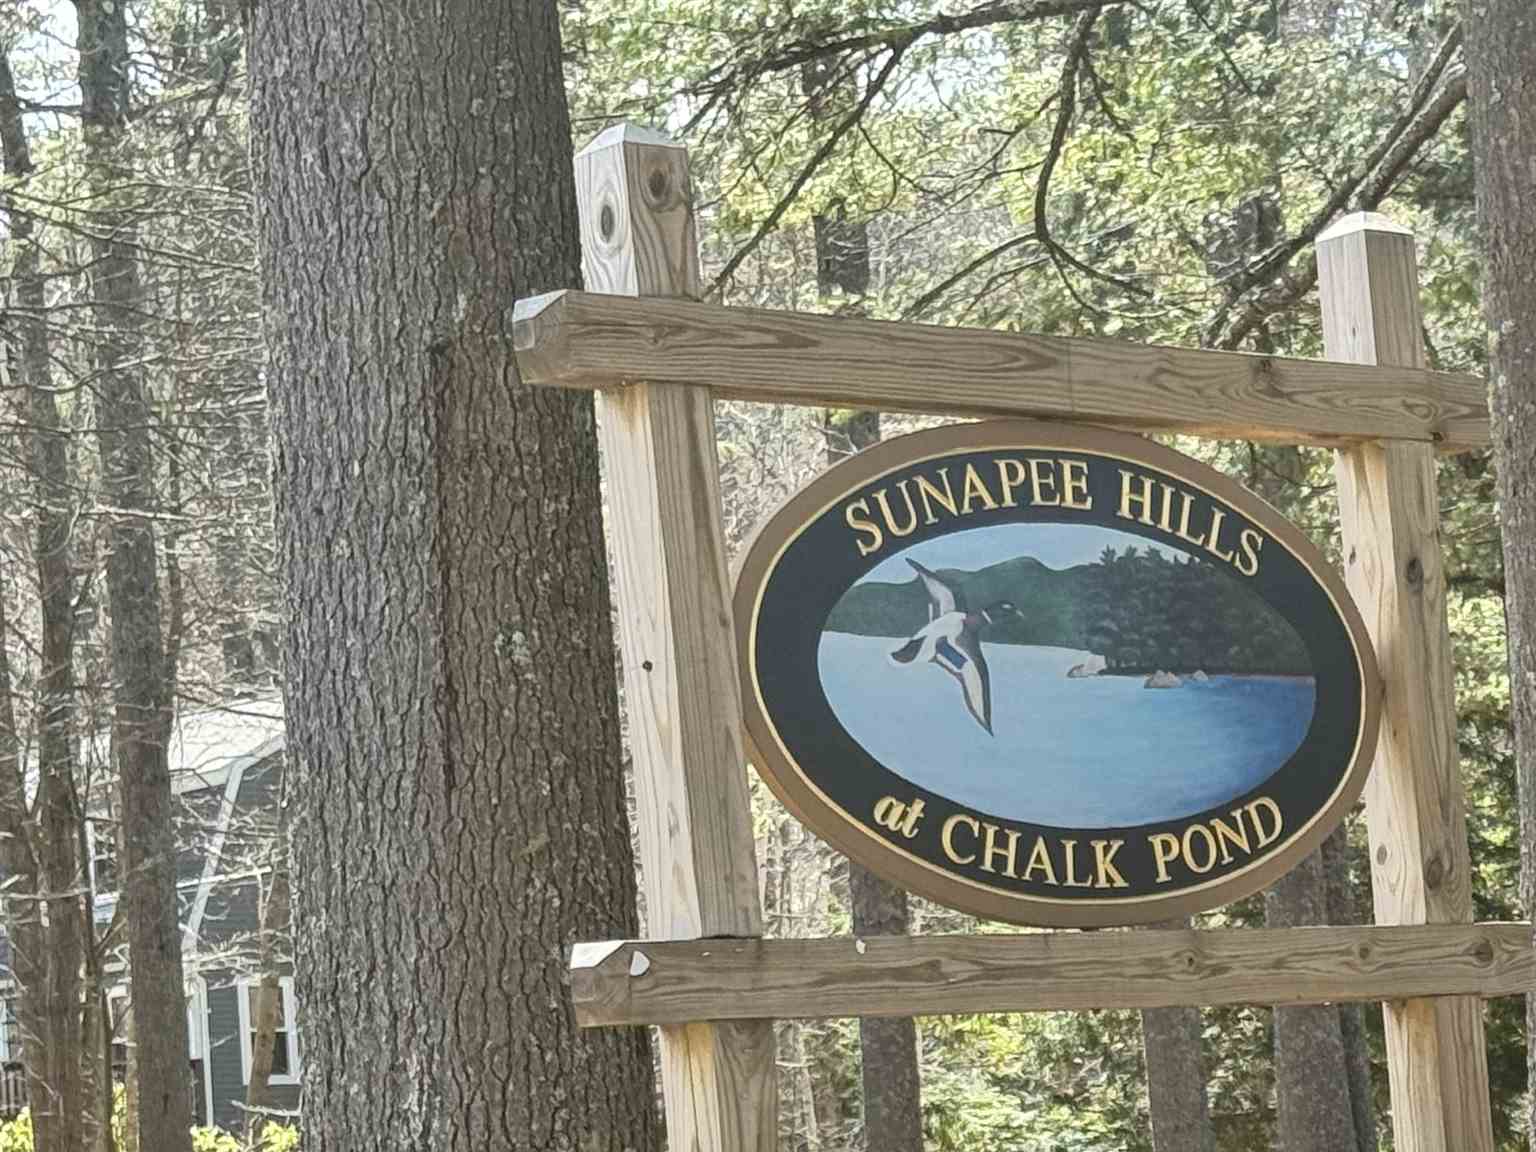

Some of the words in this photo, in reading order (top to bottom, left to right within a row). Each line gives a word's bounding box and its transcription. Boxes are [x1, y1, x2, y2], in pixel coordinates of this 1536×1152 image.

[845, 458, 1092, 556] SUNAPEE
[1116, 469, 1264, 576] HILLS
[873, 795, 925, 838] at
[941, 814, 1129, 888] CHALK
[1148, 797, 1283, 882] POND
